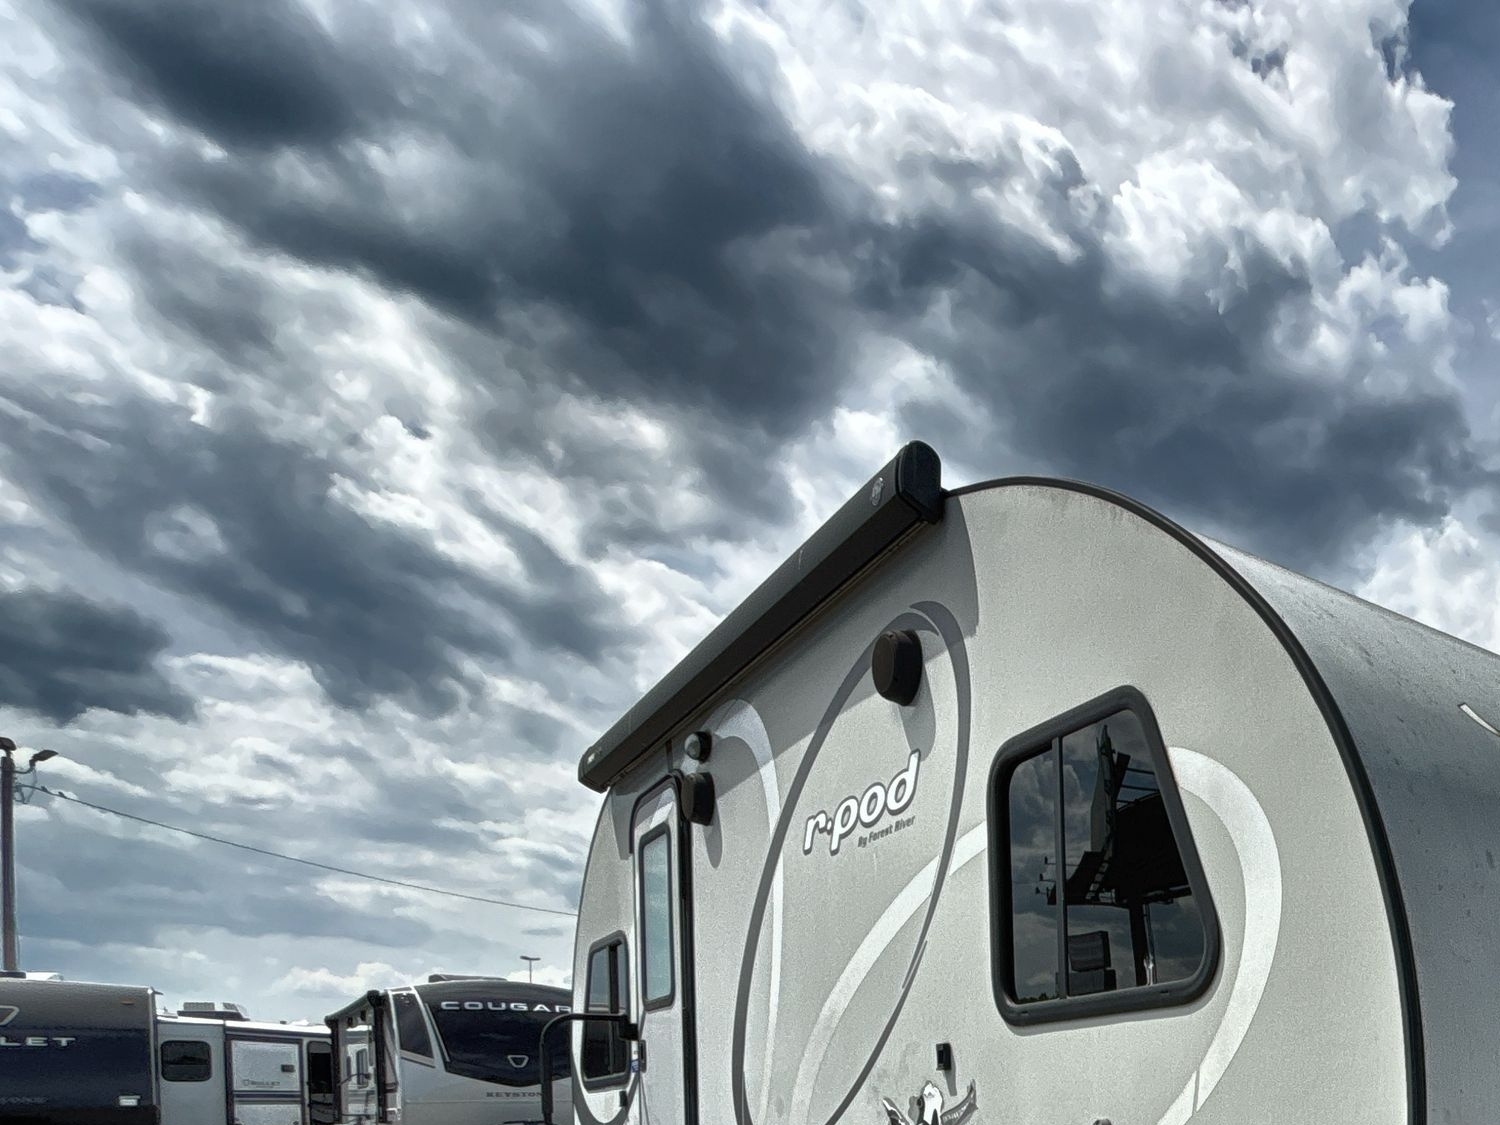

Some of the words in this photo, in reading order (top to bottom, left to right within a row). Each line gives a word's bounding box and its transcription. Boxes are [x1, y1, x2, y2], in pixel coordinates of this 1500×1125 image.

[869, 824, 893, 844] Forest
[894, 815, 916, 833] River
[440, 1001, 573, 1013] COUGAR
